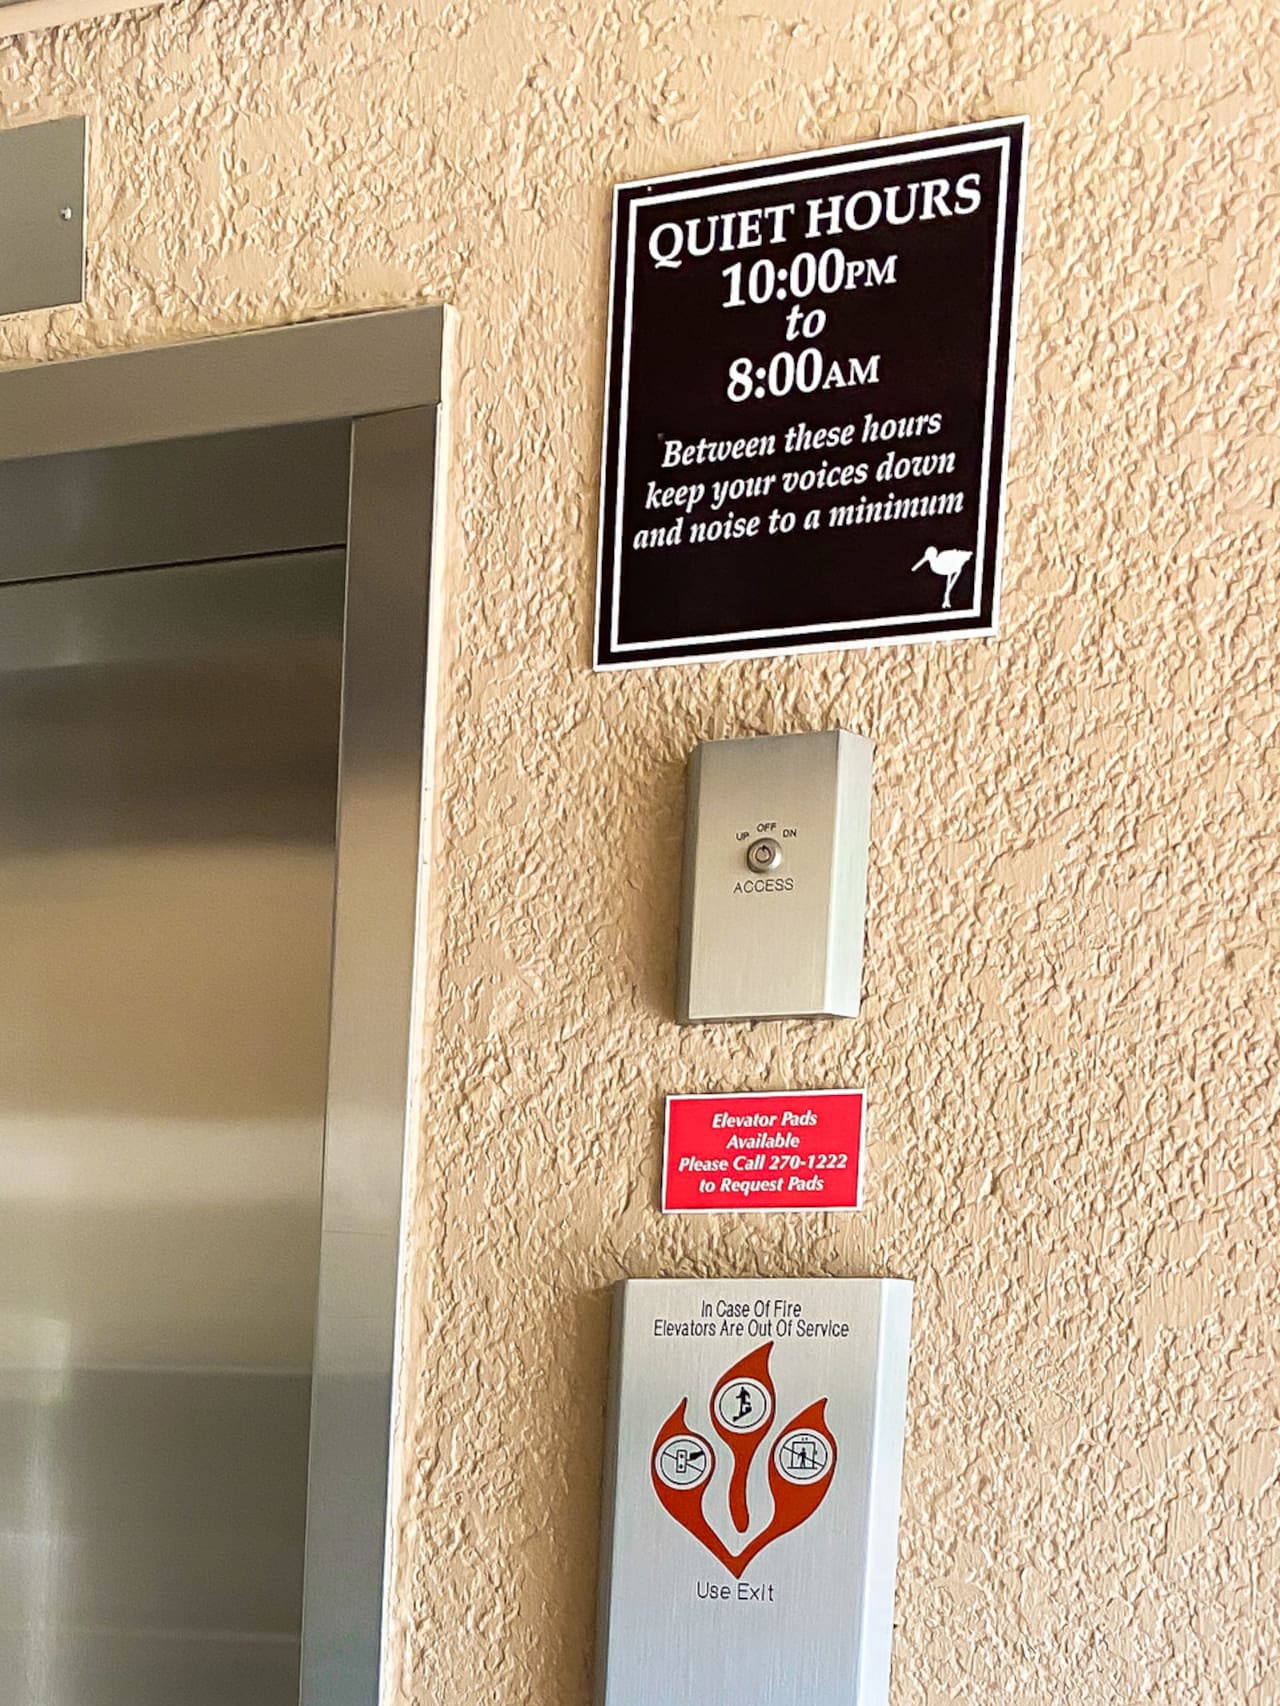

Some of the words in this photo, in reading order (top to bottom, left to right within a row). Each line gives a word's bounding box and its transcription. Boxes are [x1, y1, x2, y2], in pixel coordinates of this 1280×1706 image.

[648, 202, 795, 269] QUIET
[805, 173, 982, 236] HOURS
[721, 248, 898, 307] 10:00PM
[786, 305, 826, 341] to
[727, 349, 880, 402] 8:00AM
[661, 432, 777, 468] Between
[784, 422, 854, 452] these
[861, 412, 943, 444] hours
[645, 481, 705, 513] keep
[711, 475, 777, 509] your
[783, 459, 868, 494] voices
[876, 449, 956, 483] down
[633, 521, 682, 550] and
[689, 512, 761, 543] noise
[767, 508, 795, 534] to
[803, 510, 820, 530] a
[829, 489, 964, 528] minimum
[736, 832, 750, 841] UP
[757, 823, 777, 833] OFF
[783, 828, 797, 838] DN
[733, 878, 794, 893] ACCESS
[713, 1112, 778, 1129] Elevator
[782, 1111, 818, 1127] Pads
[726, 1133, 800, 1149] Available
[679, 1156, 729, 1172] Please
[733, 1155, 765, 1171] Call
[769, 1154, 847, 1170] 270-1222
[699, 1178, 716, 1193] to
[720, 1177, 785, 1195] Request
[788, 1176, 824, 1192] Pads
[701, 1300, 712, 1317] In
[716, 1301, 749, 1317] Case
[754, 1300, 770, 1317] Of
[774, 1301, 801, 1317] Fire
[654, 1320, 716, 1337] Elevators
[720, 1320, 744, 1336] Are
[748, 1320, 772, 1337] Out
[776, 1320, 793, 1336] Of
[796, 1320, 849, 1337] Service
[697, 1582, 731, 1600] Use
[737, 1583, 774, 1601] Exit
